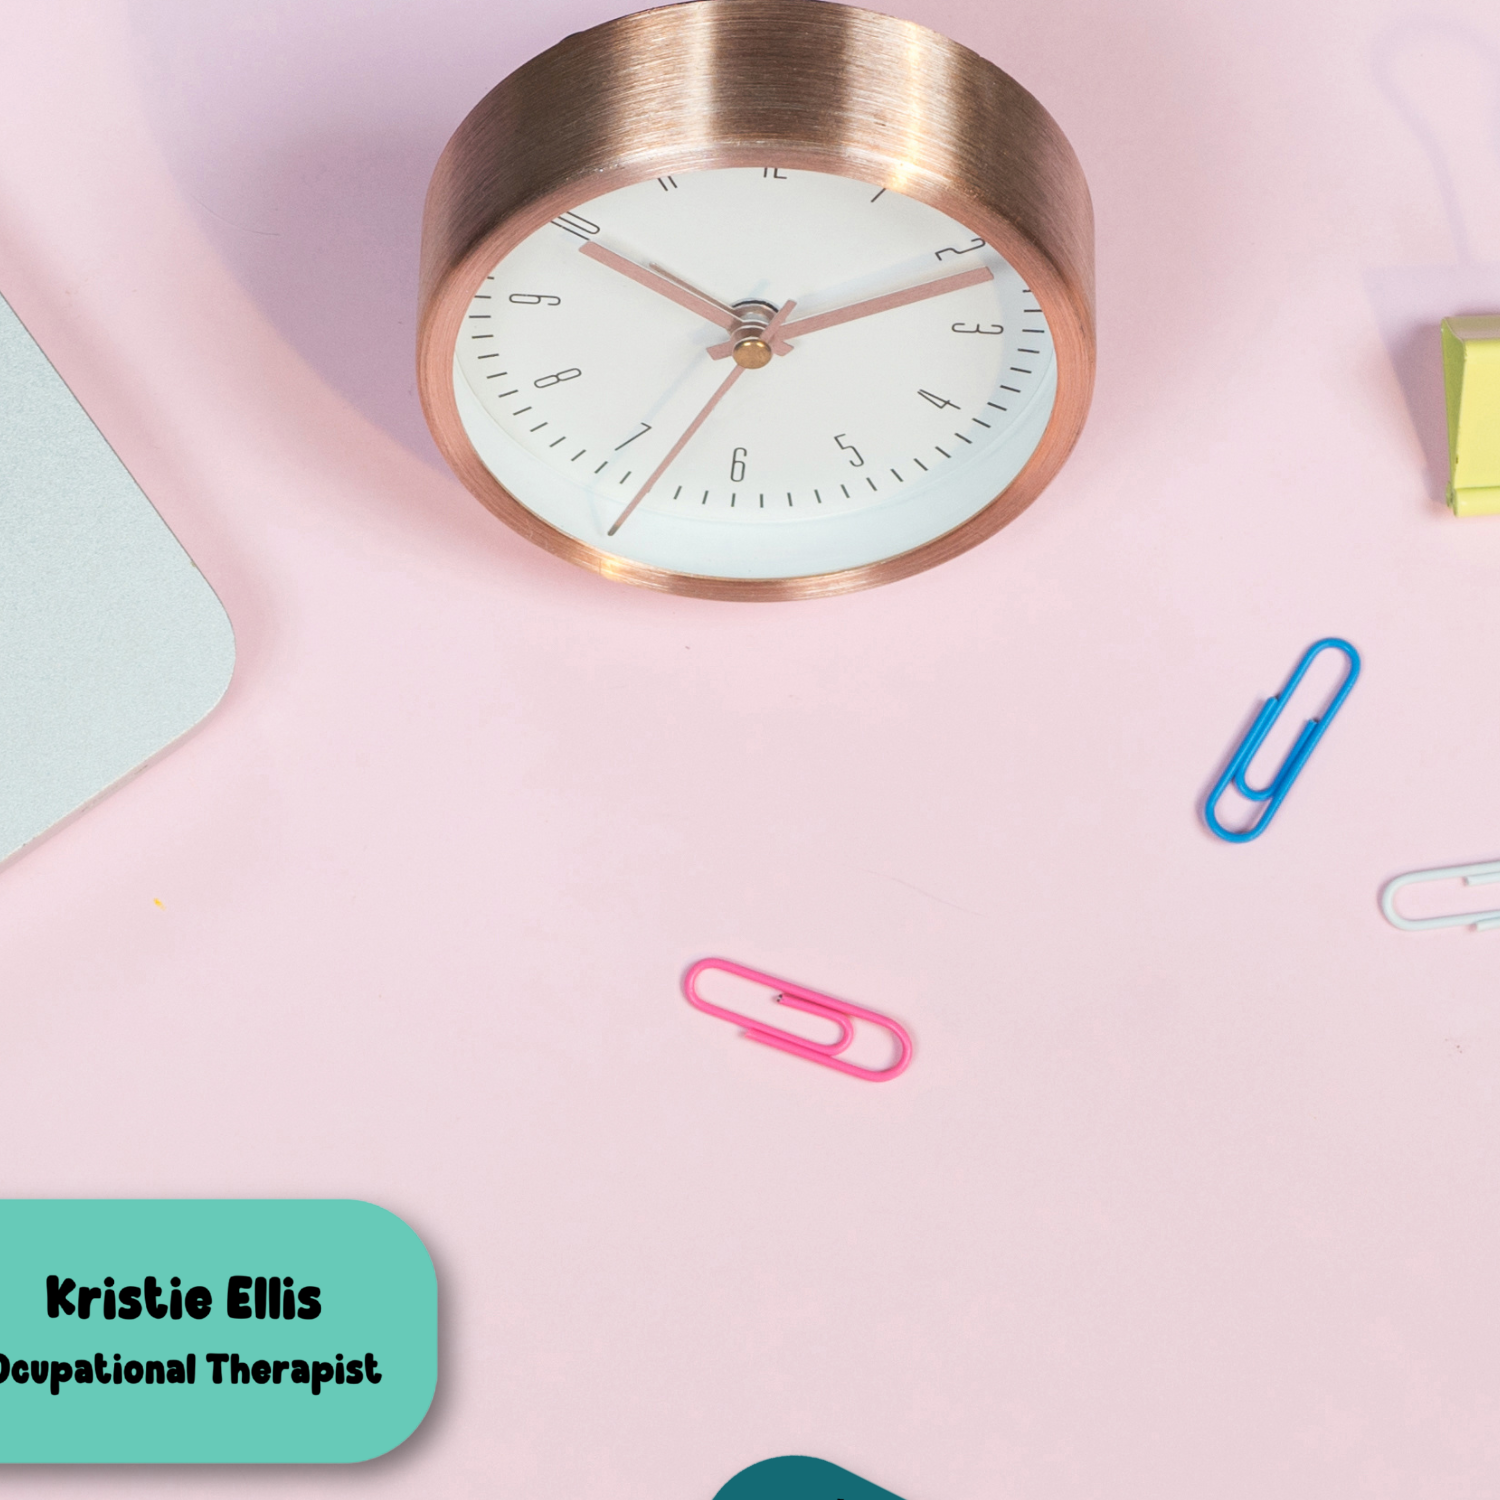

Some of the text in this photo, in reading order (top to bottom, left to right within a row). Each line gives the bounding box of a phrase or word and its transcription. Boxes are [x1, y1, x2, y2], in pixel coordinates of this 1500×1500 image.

[551, 211, 601, 241] 10
[934, 237, 986, 261] 2
[508, 292, 562, 307] 9
[950, 322, 1005, 336] 3
[533, 366, 583, 389] 8
[916, 387, 962, 411] 4
[614, 421, 653, 452] 7
[833, 432, 865, 468] 5
[729, 446, 748, 483] 6
[45, 1275, 322, 1321] Kristie Ellis
[205, 1352, 383, 1396] Therapist
